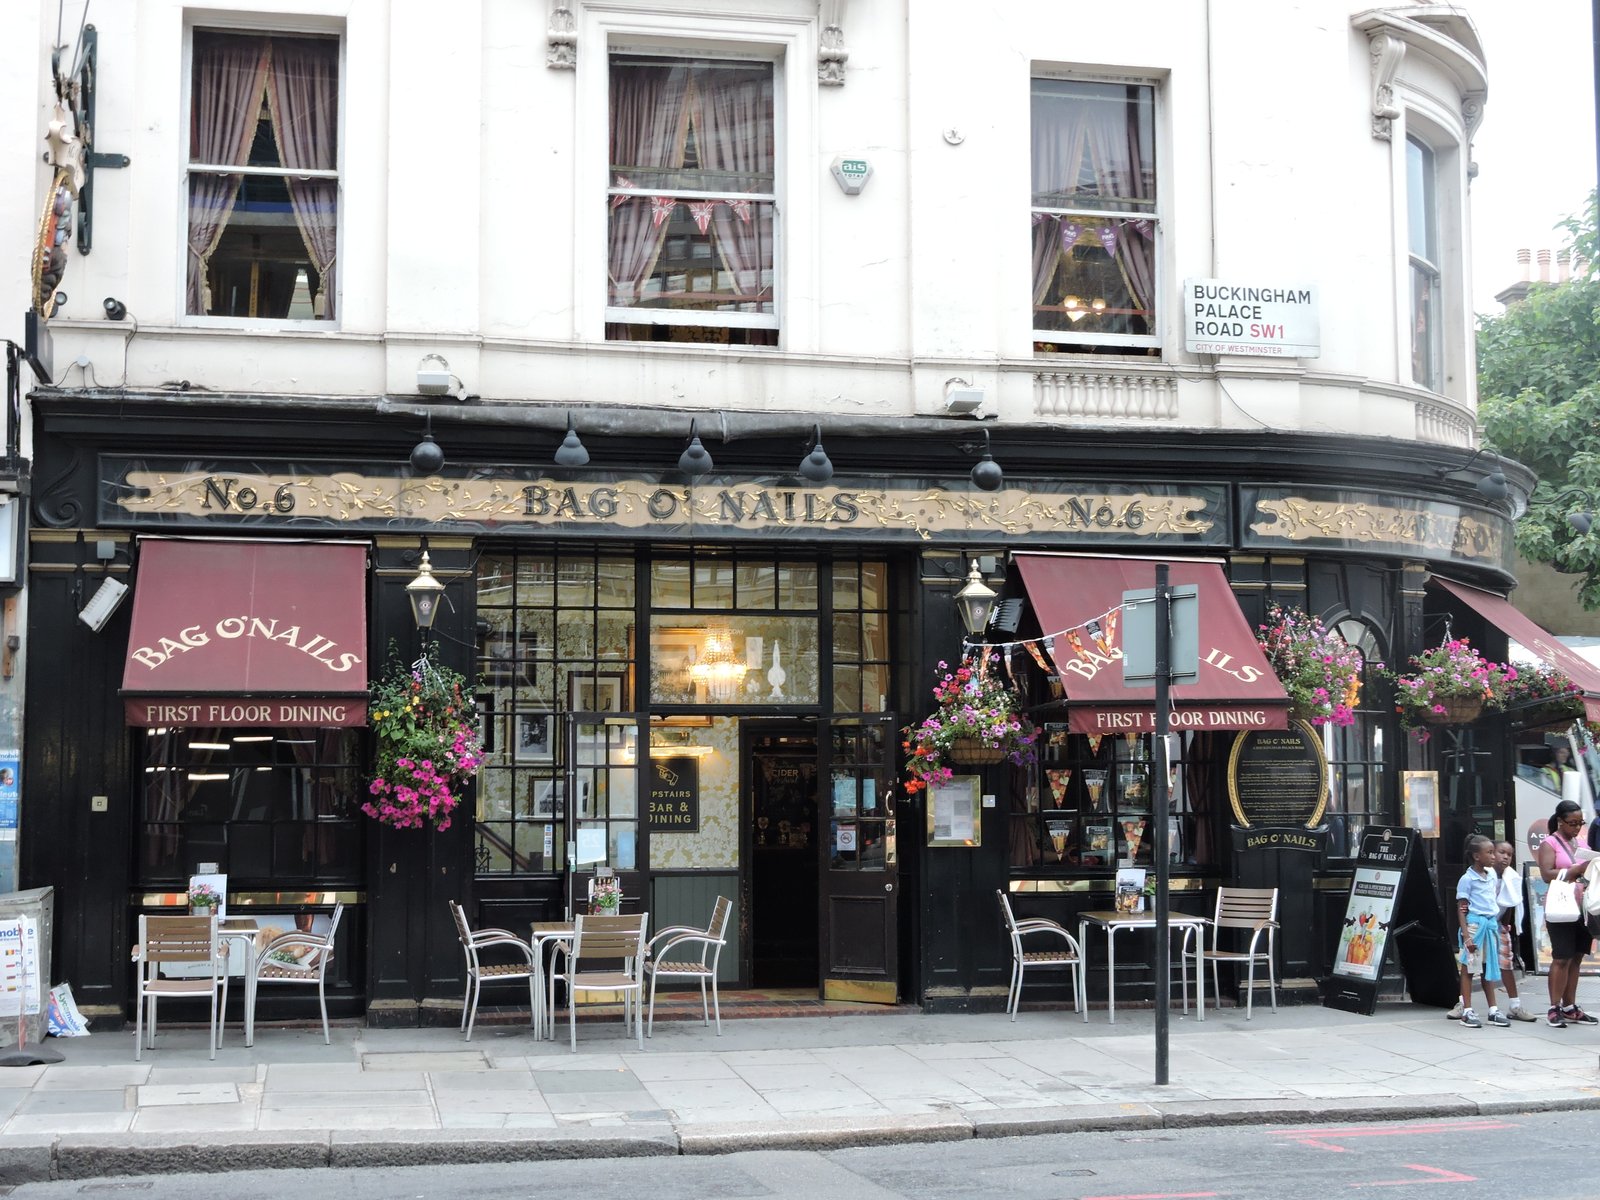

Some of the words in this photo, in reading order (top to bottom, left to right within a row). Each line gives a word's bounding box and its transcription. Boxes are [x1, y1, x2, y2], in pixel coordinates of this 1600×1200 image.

[1194, 285, 1311, 304] BUCKINGHAM
[1195, 303, 1262, 320] PALACE
[1195, 321, 1244, 337] ROAD
[1250, 324, 1284, 339] SW1
[1215, 344, 1225, 352] OF
[1228, 345, 1282, 354] WESTMINSTER
[522, 485, 618, 517] BAG
[718, 489, 859, 523] NAILS
[132, 625, 211, 671] BAG
[146, 706, 201, 722] FIRST
[208, 705, 272, 722] FLOOR
[279, 705, 346, 722] DINING
[1096, 712, 1143, 728] FIRST
[1150, 711, 1204, 727] FOOR
[1209, 710, 1266, 726] DINING
[771, 769, 799, 777] CIDER
[650, 790, 691, 798] PSTAIRS
[649, 802, 673, 812] BAR
[679, 801, 689, 812] &
[1247, 835, 1268, 847] BAG
[1283, 834, 1317, 848] NAILS
[1368, 852, 1378, 860] BAG
[1382, 853, 1397, 861] NAILS
[1379, 845, 1390, 853] THE
